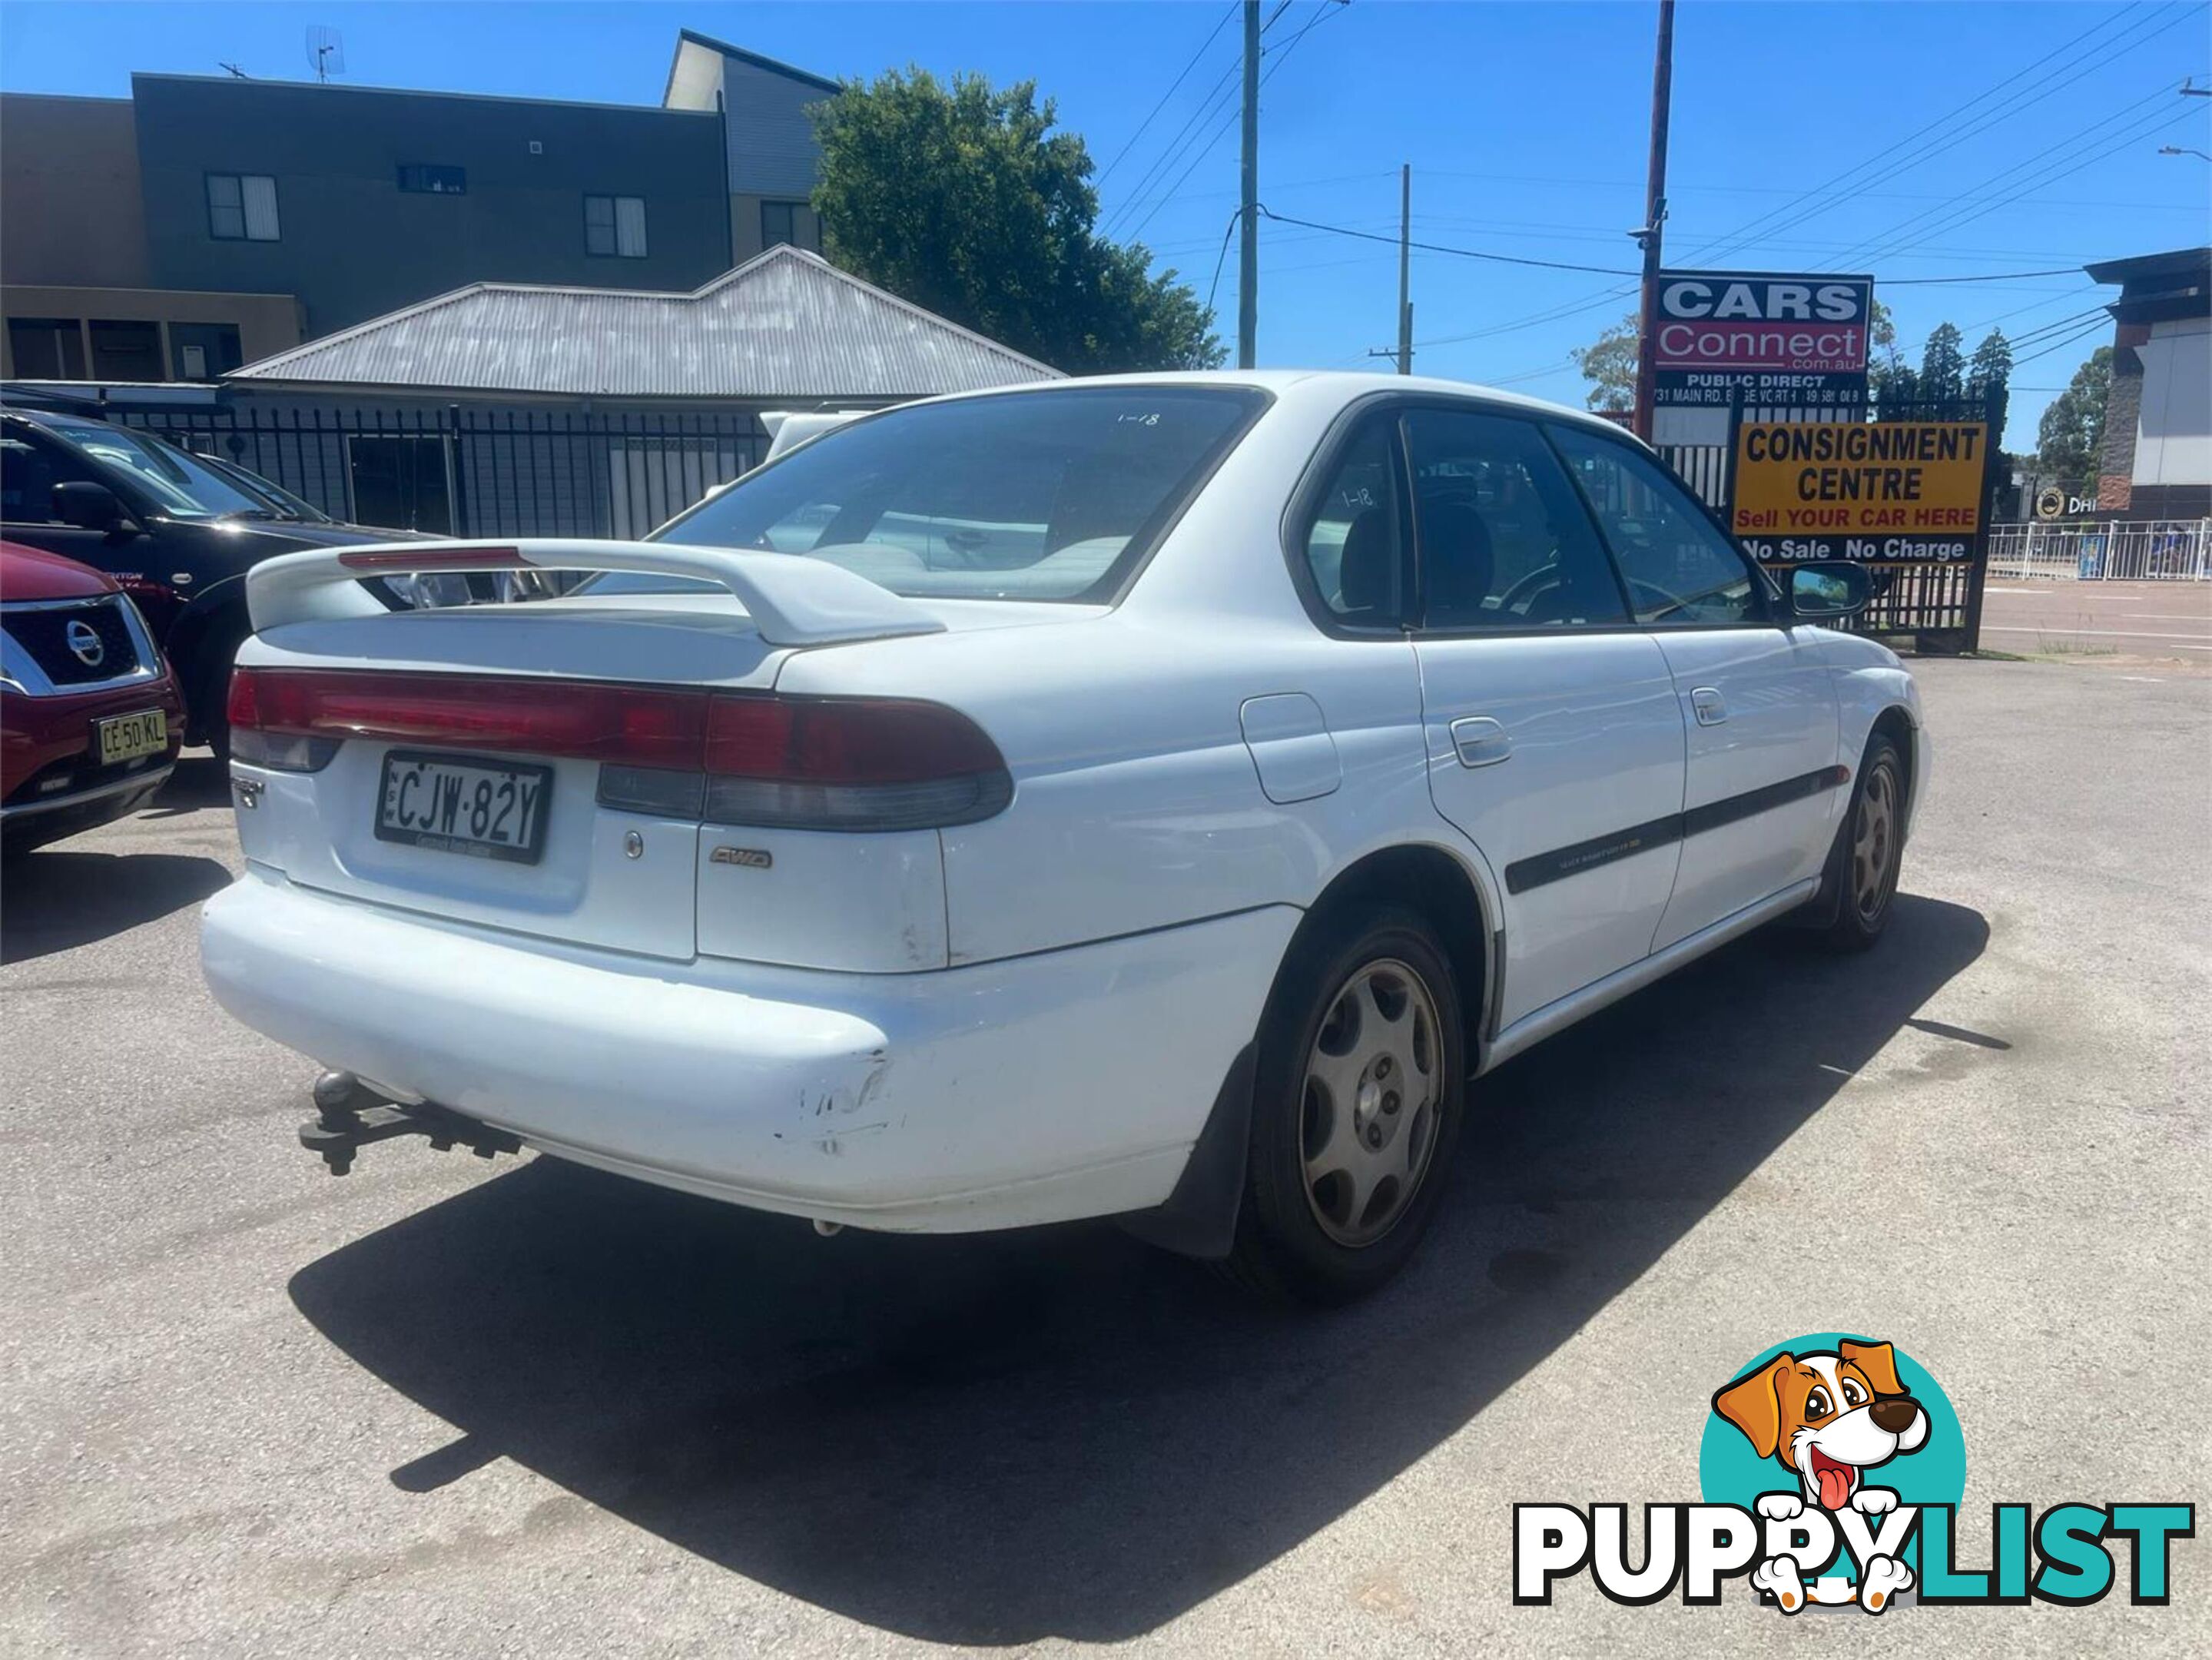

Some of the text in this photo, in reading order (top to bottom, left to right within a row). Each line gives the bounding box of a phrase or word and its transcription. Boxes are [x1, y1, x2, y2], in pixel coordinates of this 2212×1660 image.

[1663, 282, 1858, 320] CARS
[1660, 324, 1857, 357] Connect
[1787, 357, 1857, 370] .com.au
[1687, 374, 1826, 387] PUBLIC DIRECT
[1673, 389, 1702, 402] MAIN
[1704, 389, 1723, 403] RD.
[1746, 427, 1980, 461] CONSIGNMENT
[1798, 467, 1923, 500] CENTRE
[1736, 508, 1975, 527] Sell YOUR CAR HERE
[1742, 539, 1965, 561] No Sale No Charge
